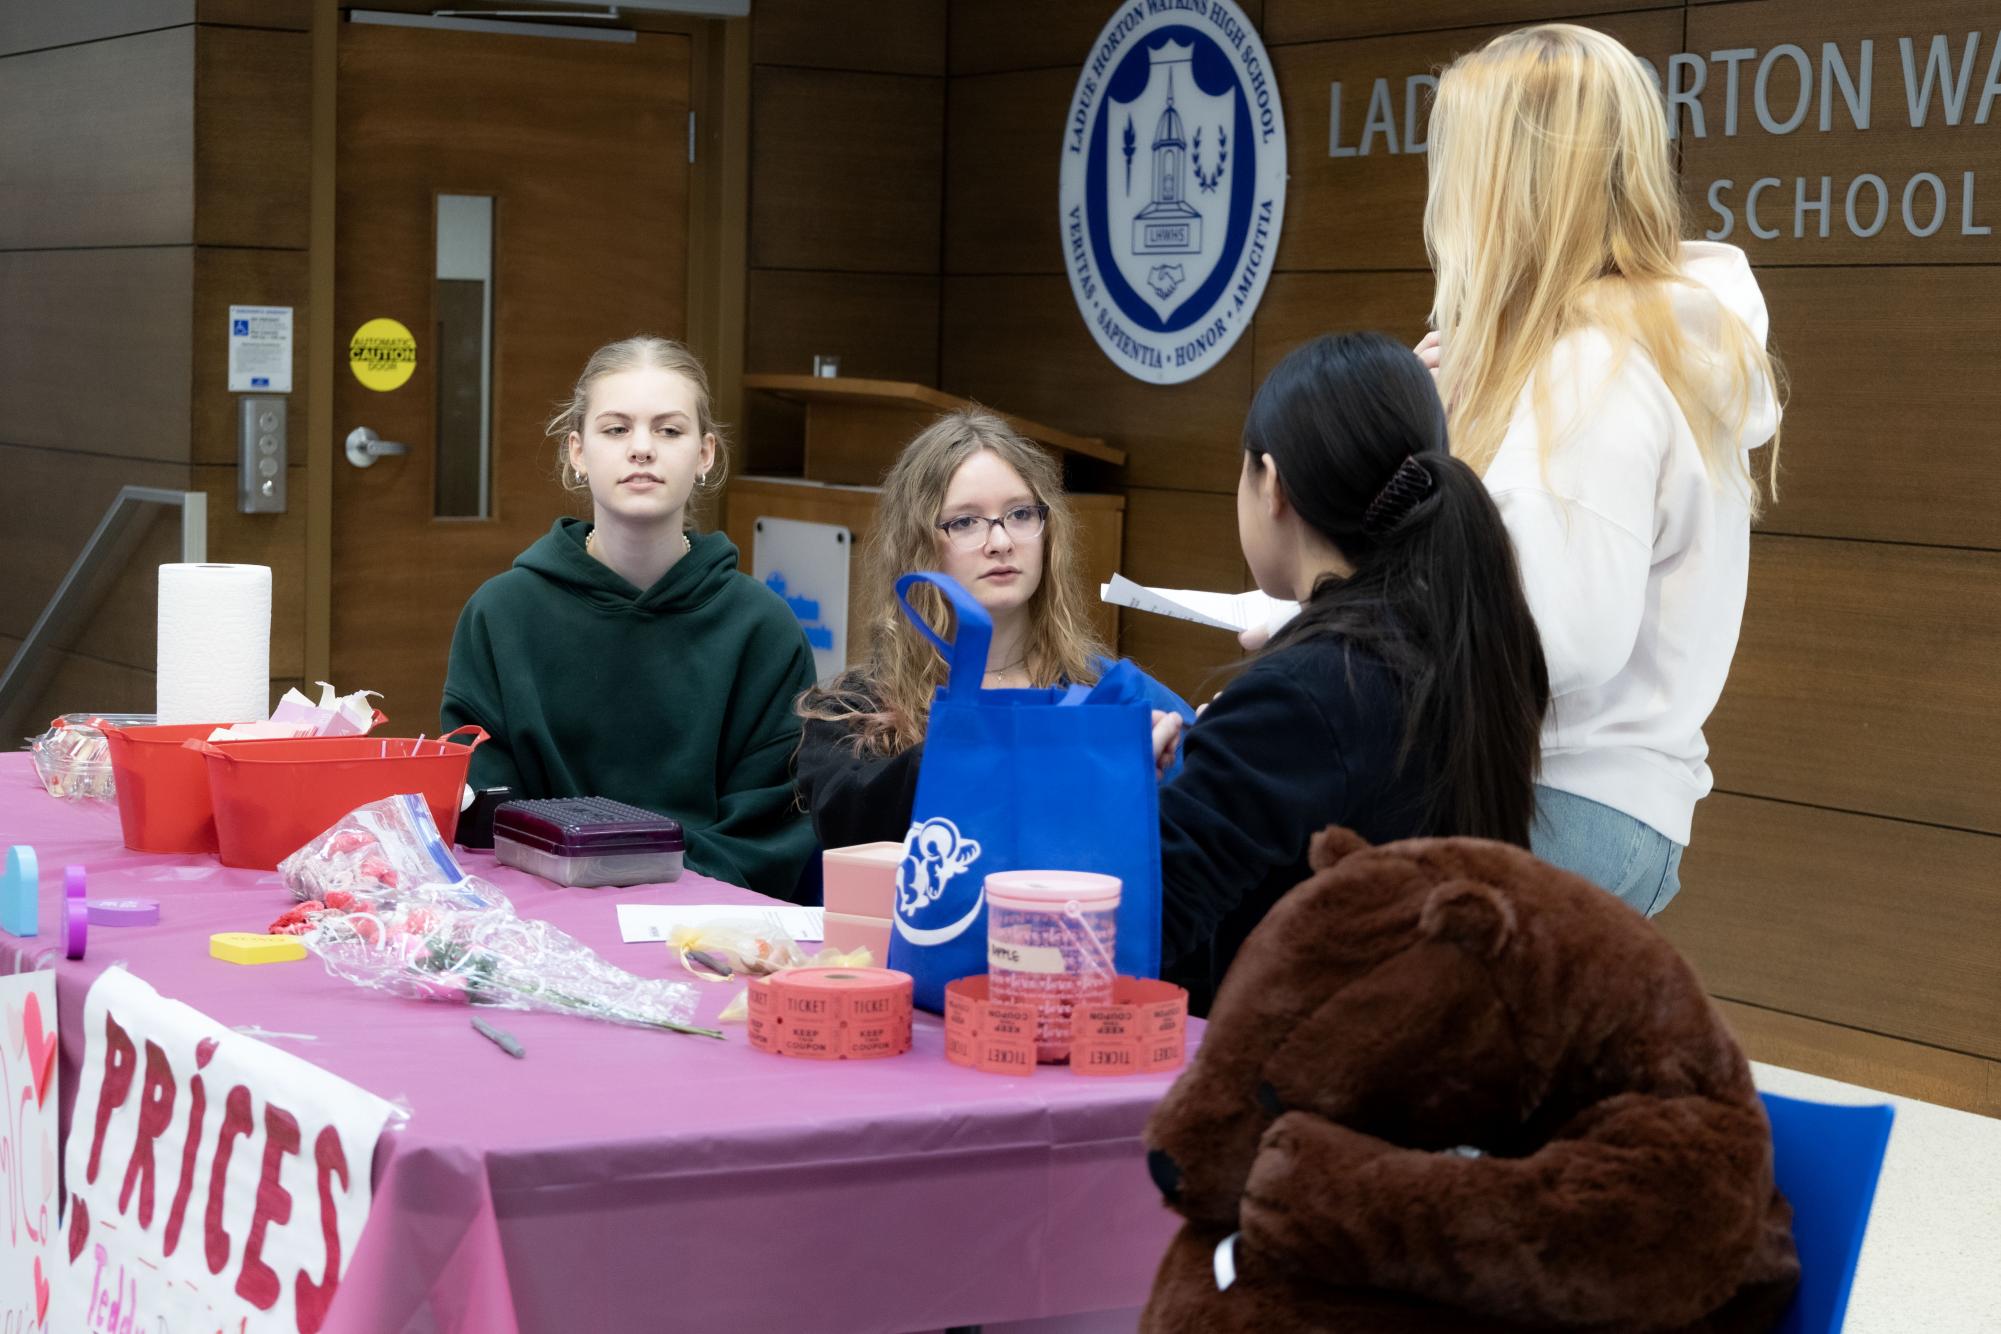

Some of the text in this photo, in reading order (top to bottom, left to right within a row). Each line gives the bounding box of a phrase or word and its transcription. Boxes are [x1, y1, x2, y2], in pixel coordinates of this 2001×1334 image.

[1071, 75, 1098, 154] LADUE
[1094, 4, 1144, 76] HORTON
[1209, 2, 1246, 51] HIGH
[1241, 44, 1276, 144] SCHOOL
[1328, 74, 1438, 157] LAD
[1635, 38, 1874, 140] RTON
[1706, 171, 1991, 241] SCHOOL
[1151, 227, 1185, 243] LHWHS
[1069, 200, 1274, 369] VERITAS SAPIENTIA HONOR AMICITIA
[351, 347, 416, 361] CAUTION
[788, 998, 826, 1014] TICKET
[854, 998, 890, 1013] TICKET
[987, 1010, 1029, 1021] COUPON
[1089, 1012, 1132, 1021] COUPON
[793, 1028, 819, 1037] KEEP
[860, 1028, 884, 1037] KEEP
[994, 1024, 1021, 1034] KEEP
[1096, 1026, 1124, 1035] KEEP
[786, 1041, 827, 1051] COUPON
[852, 1041, 890, 1051] COUPON
[987, 1047, 1026, 1065] TICKET
[1089, 1050, 1130, 1065] TICKET
